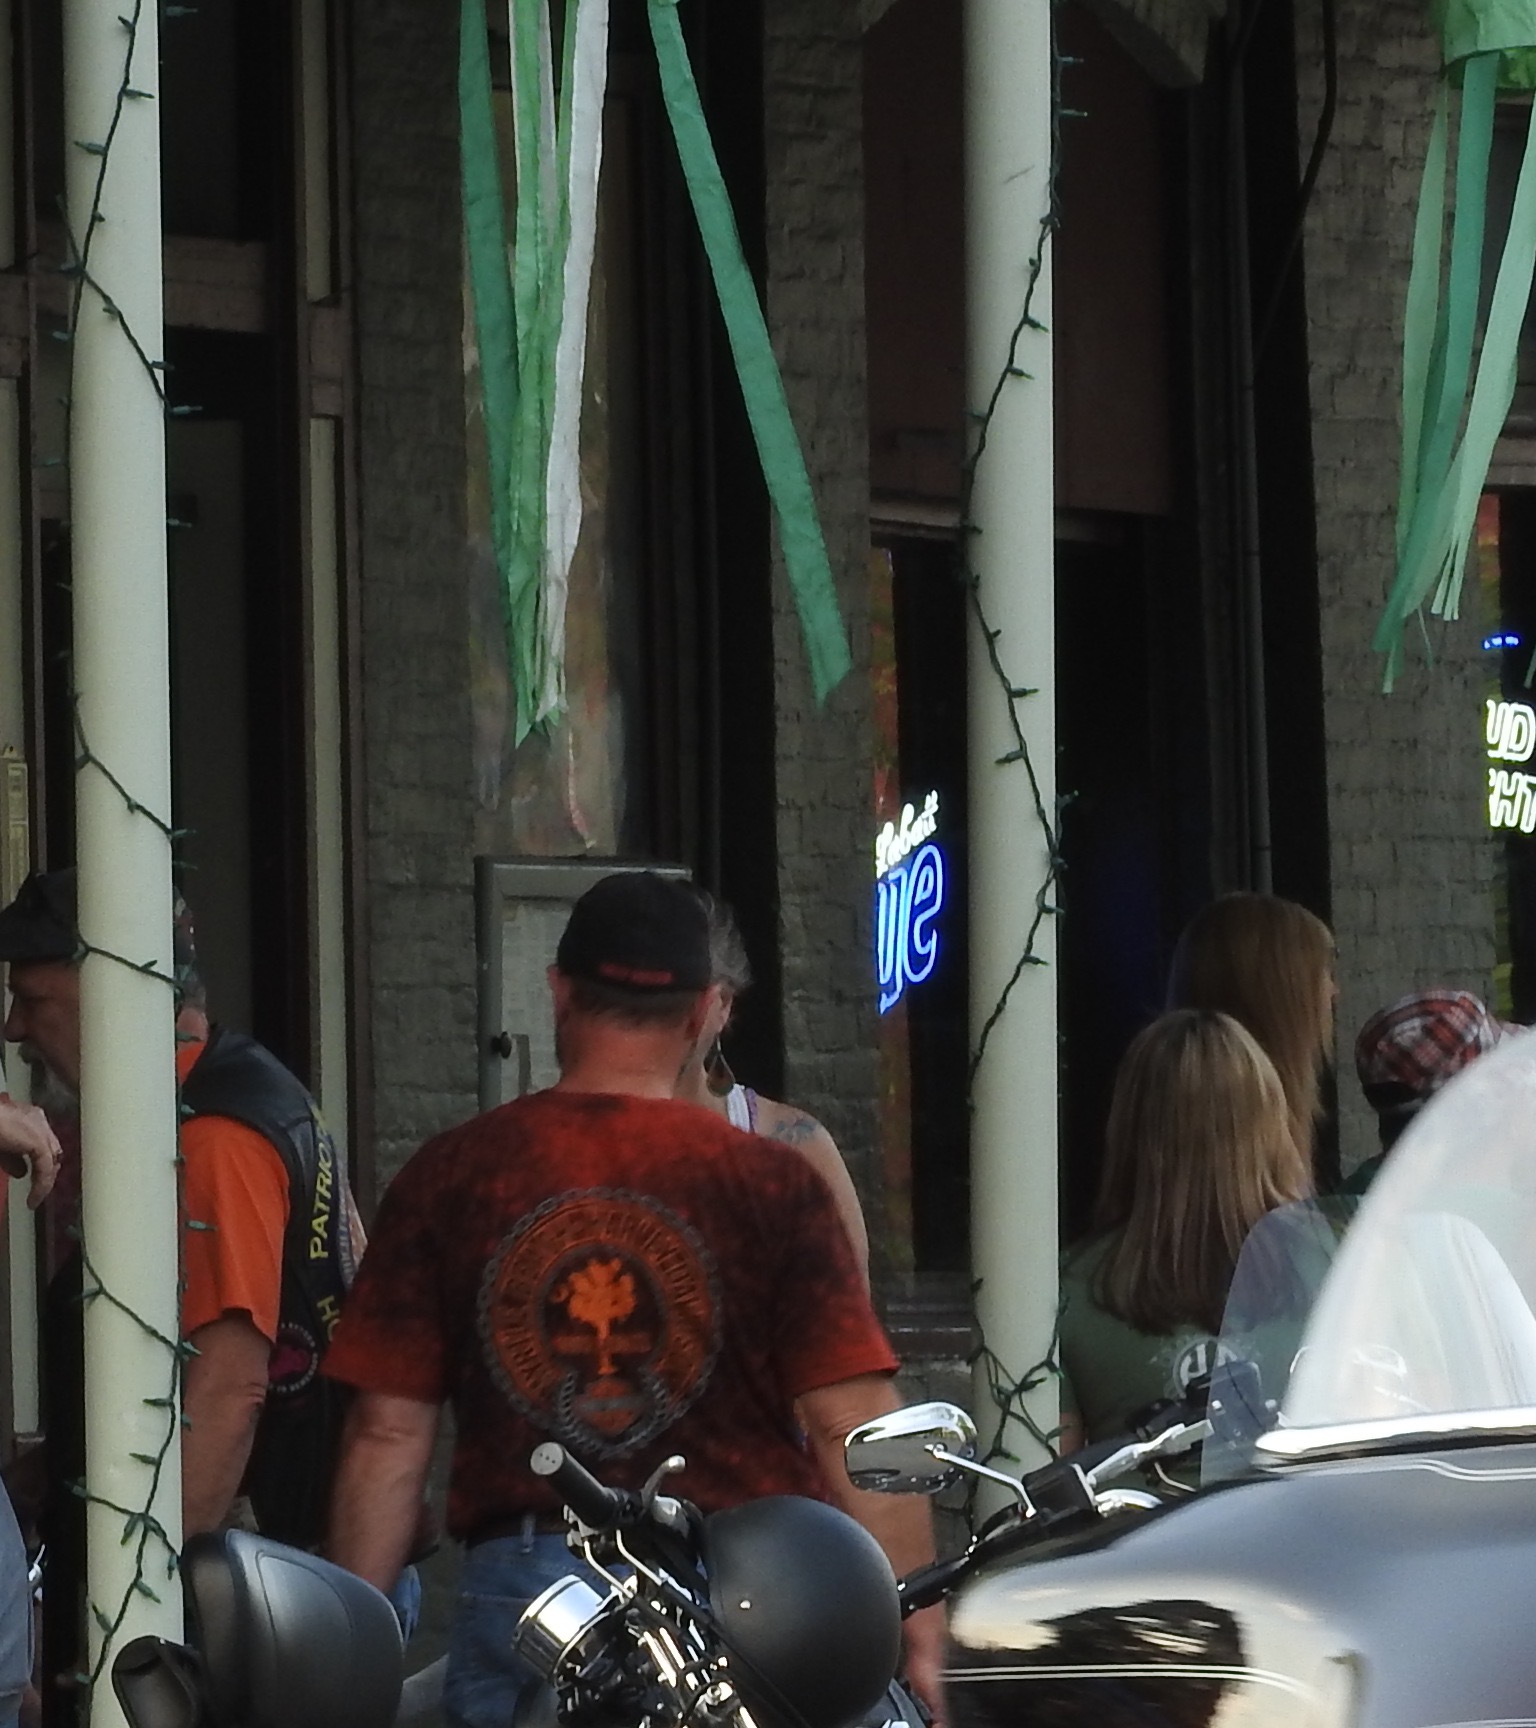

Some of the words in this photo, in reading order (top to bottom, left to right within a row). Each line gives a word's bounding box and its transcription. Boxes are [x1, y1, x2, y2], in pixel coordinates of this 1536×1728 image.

[1486, 700, 1536, 763] UD
[876, 790, 939, 880] Labatt
[309, 1130, 334, 1260] PATRIO
